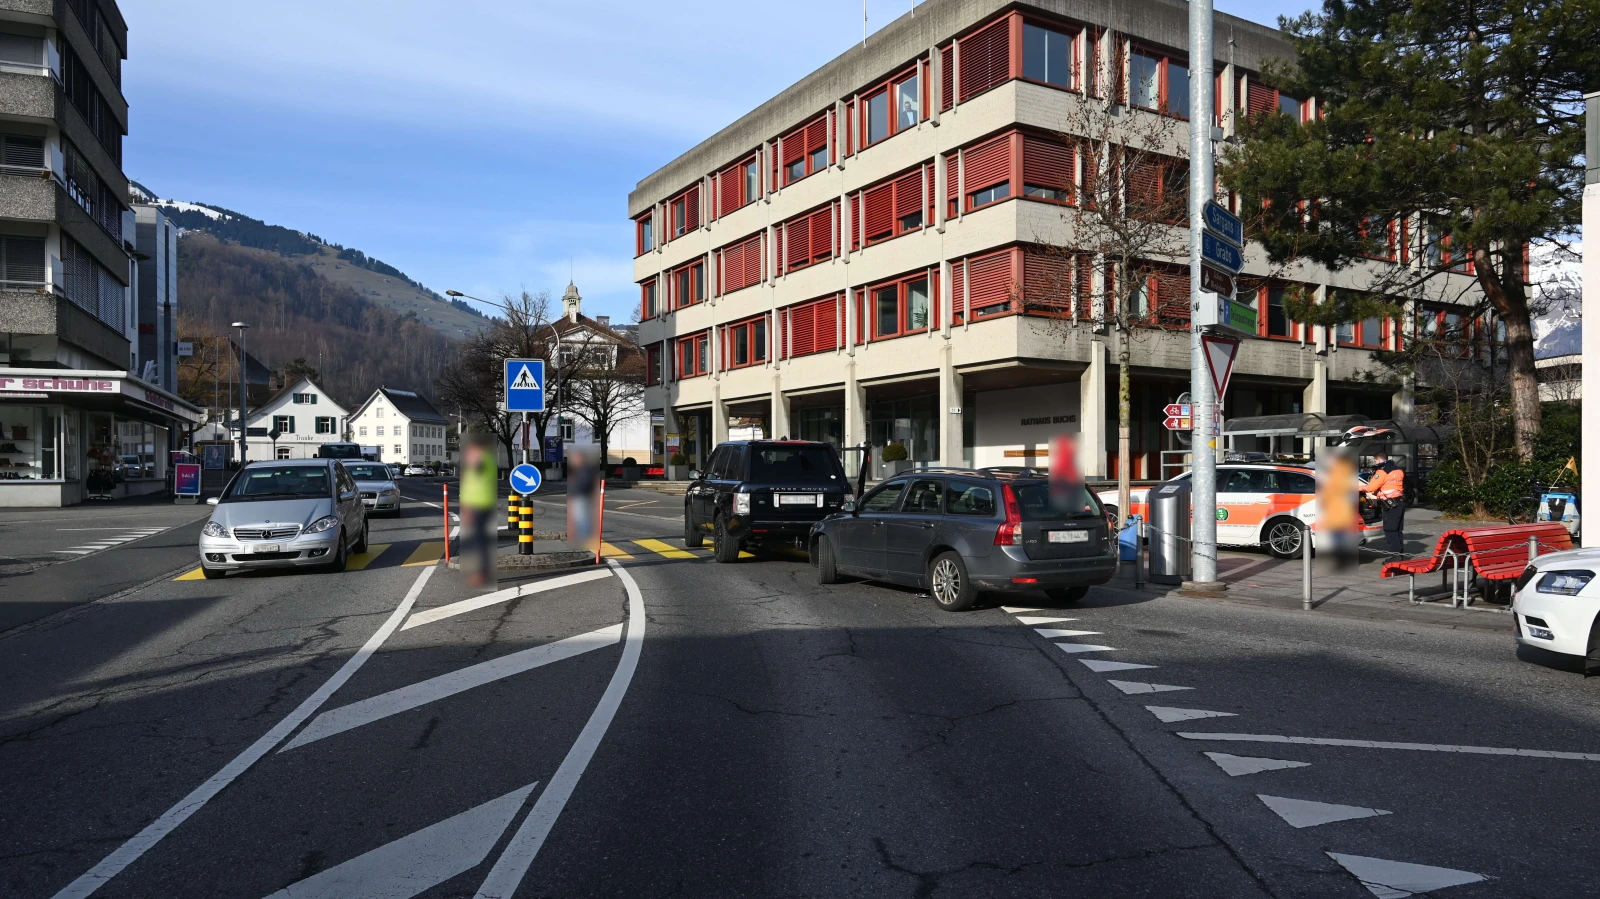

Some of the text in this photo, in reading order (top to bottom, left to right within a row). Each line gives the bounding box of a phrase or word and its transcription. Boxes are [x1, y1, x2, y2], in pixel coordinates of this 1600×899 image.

[1212, 206, 1234, 235] Sargans
[1215, 241, 1233, 264] Grabs
[22, 376, 113, 391] schuhe
[1020, 415, 1077, 426] RATHAUS BUCHS
